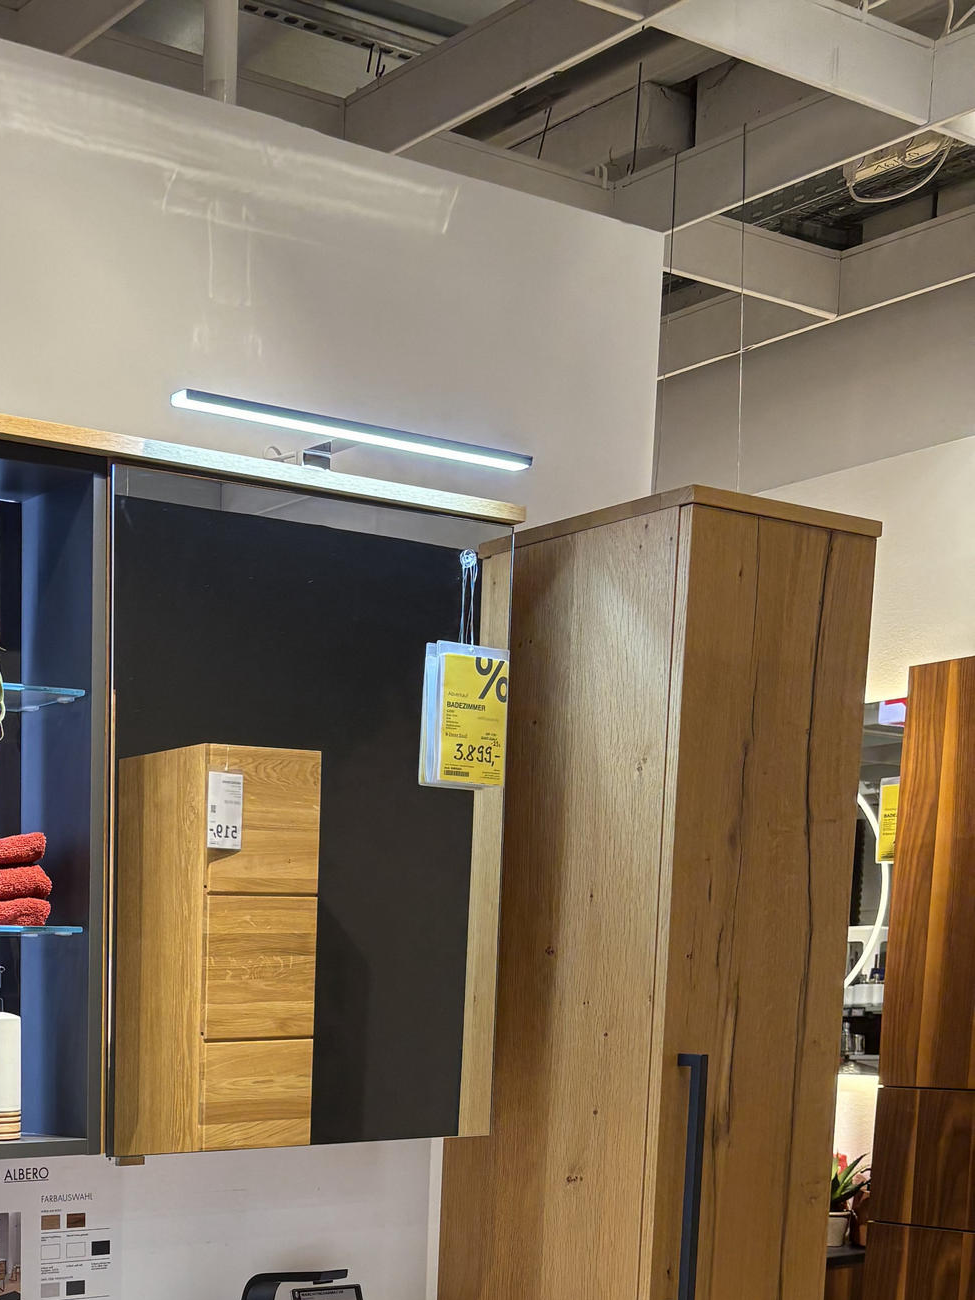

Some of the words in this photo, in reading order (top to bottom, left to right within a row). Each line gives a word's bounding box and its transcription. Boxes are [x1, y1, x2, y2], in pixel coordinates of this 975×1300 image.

[446, 701, 486, 712] BADEZIMMER
[453, 743, 501, 767] 3.899,-
[3, 1166, 49, 1181] ALBERO
[41, 1192, 94, 1204] FARBAUSWAHL
